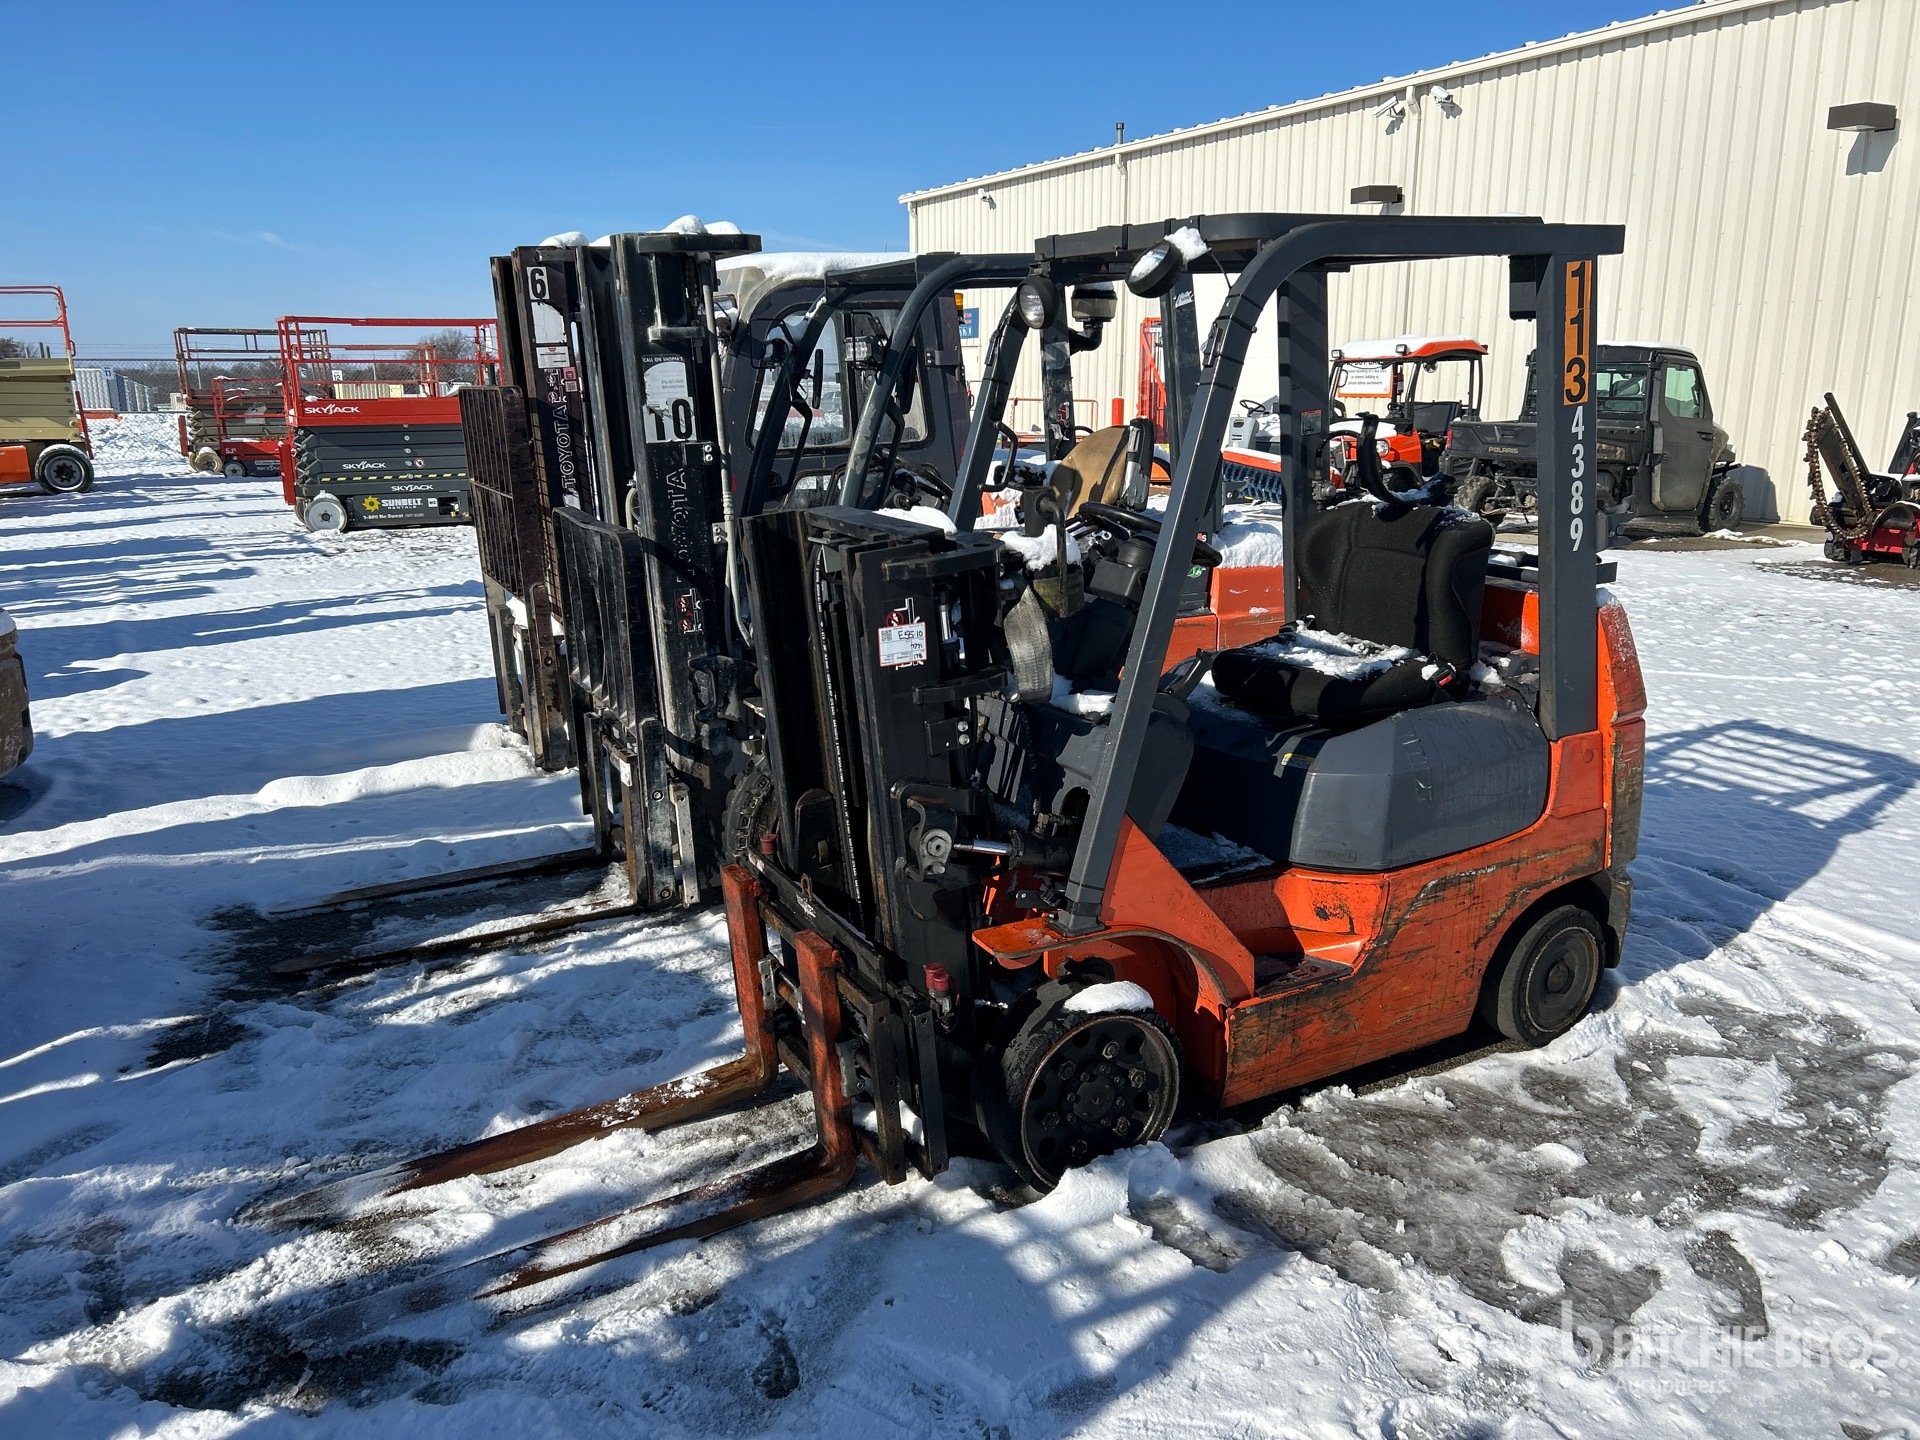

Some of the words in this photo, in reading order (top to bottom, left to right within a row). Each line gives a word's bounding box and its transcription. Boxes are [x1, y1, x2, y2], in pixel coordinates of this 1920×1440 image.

[530, 267, 547, 299] 6
[304, 403, 361, 415] SKYJACK
[649, 399, 693, 440] 10
[552, 404, 577, 490] TOYOTA
[1488, 446, 1519, 454] POLARIS
[342, 460, 387, 471] SKYJACK
[1569, 405, 1585, 552] 4389
[390, 484, 434, 493] SKYJACK
[381, 498, 424, 508] SUNBELT
